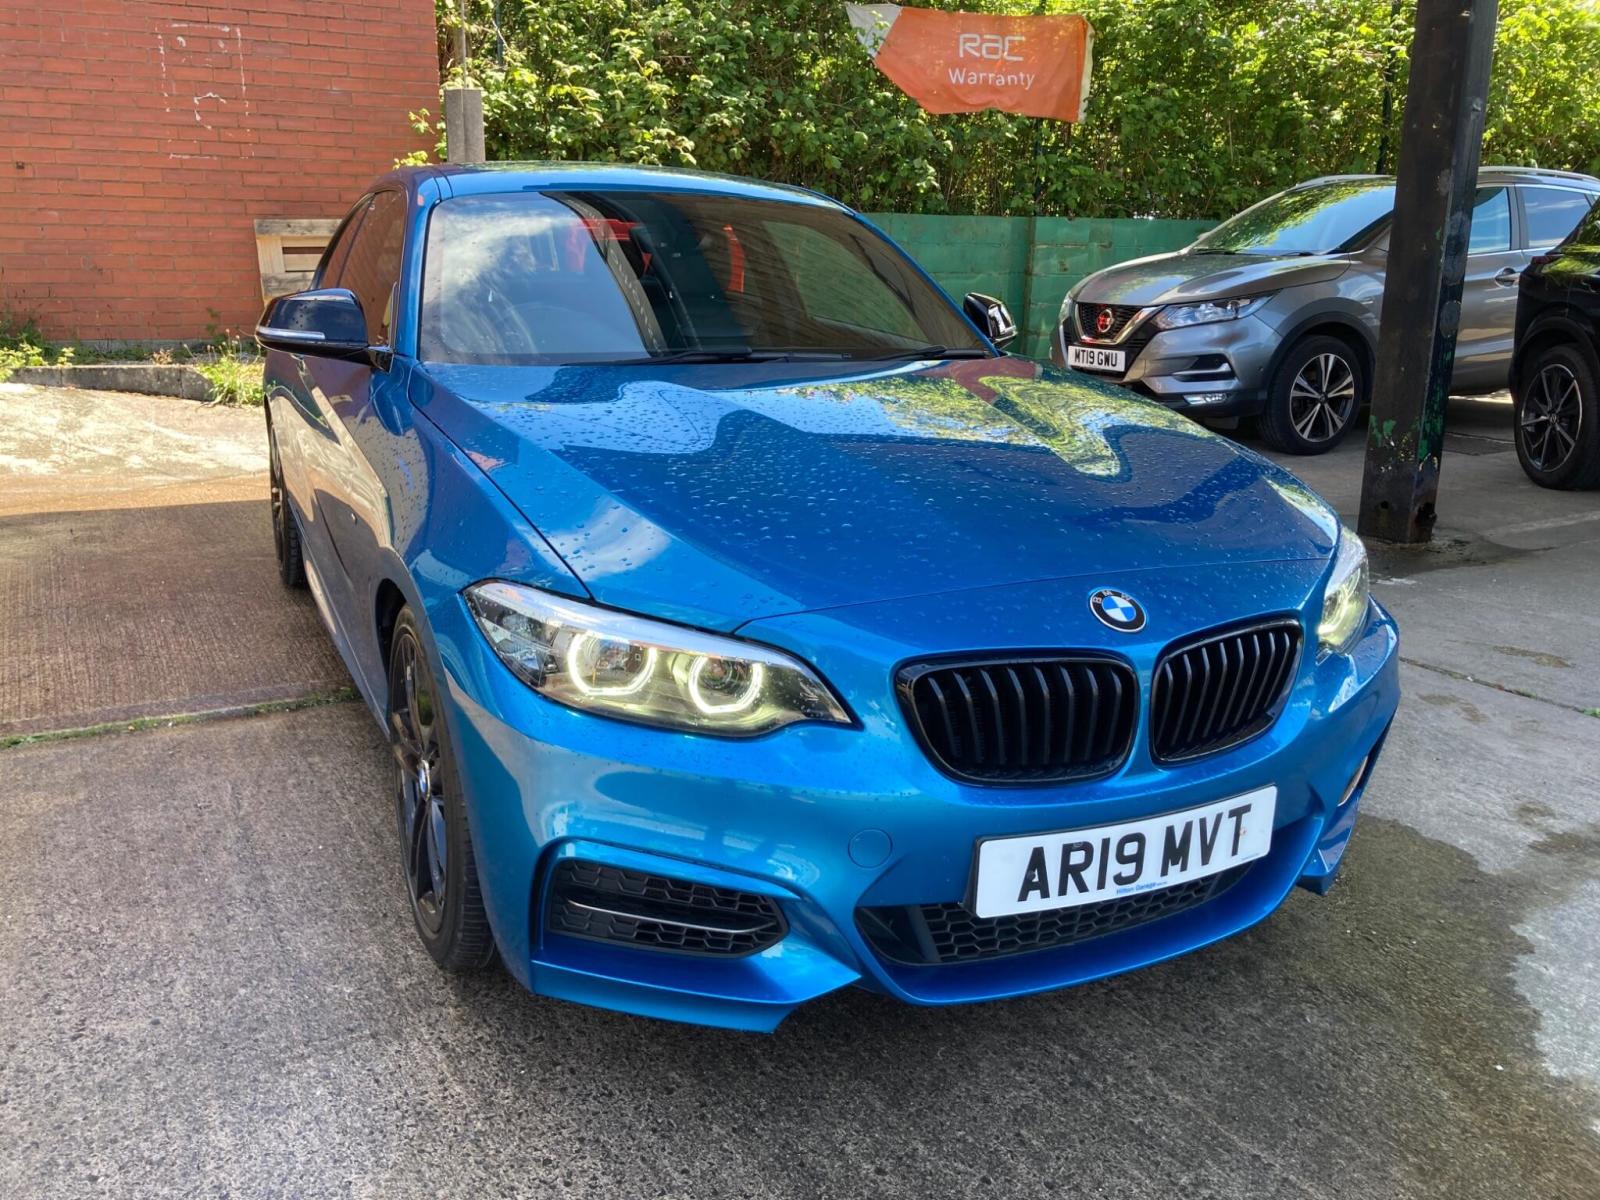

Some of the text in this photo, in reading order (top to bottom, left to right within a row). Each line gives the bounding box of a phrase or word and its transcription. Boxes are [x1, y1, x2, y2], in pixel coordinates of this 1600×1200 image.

[948, 67, 1035, 91] Warranty
[1074, 349, 1118, 367] MT19 GWU
[1017, 803, 1252, 902] AR19 MVT
